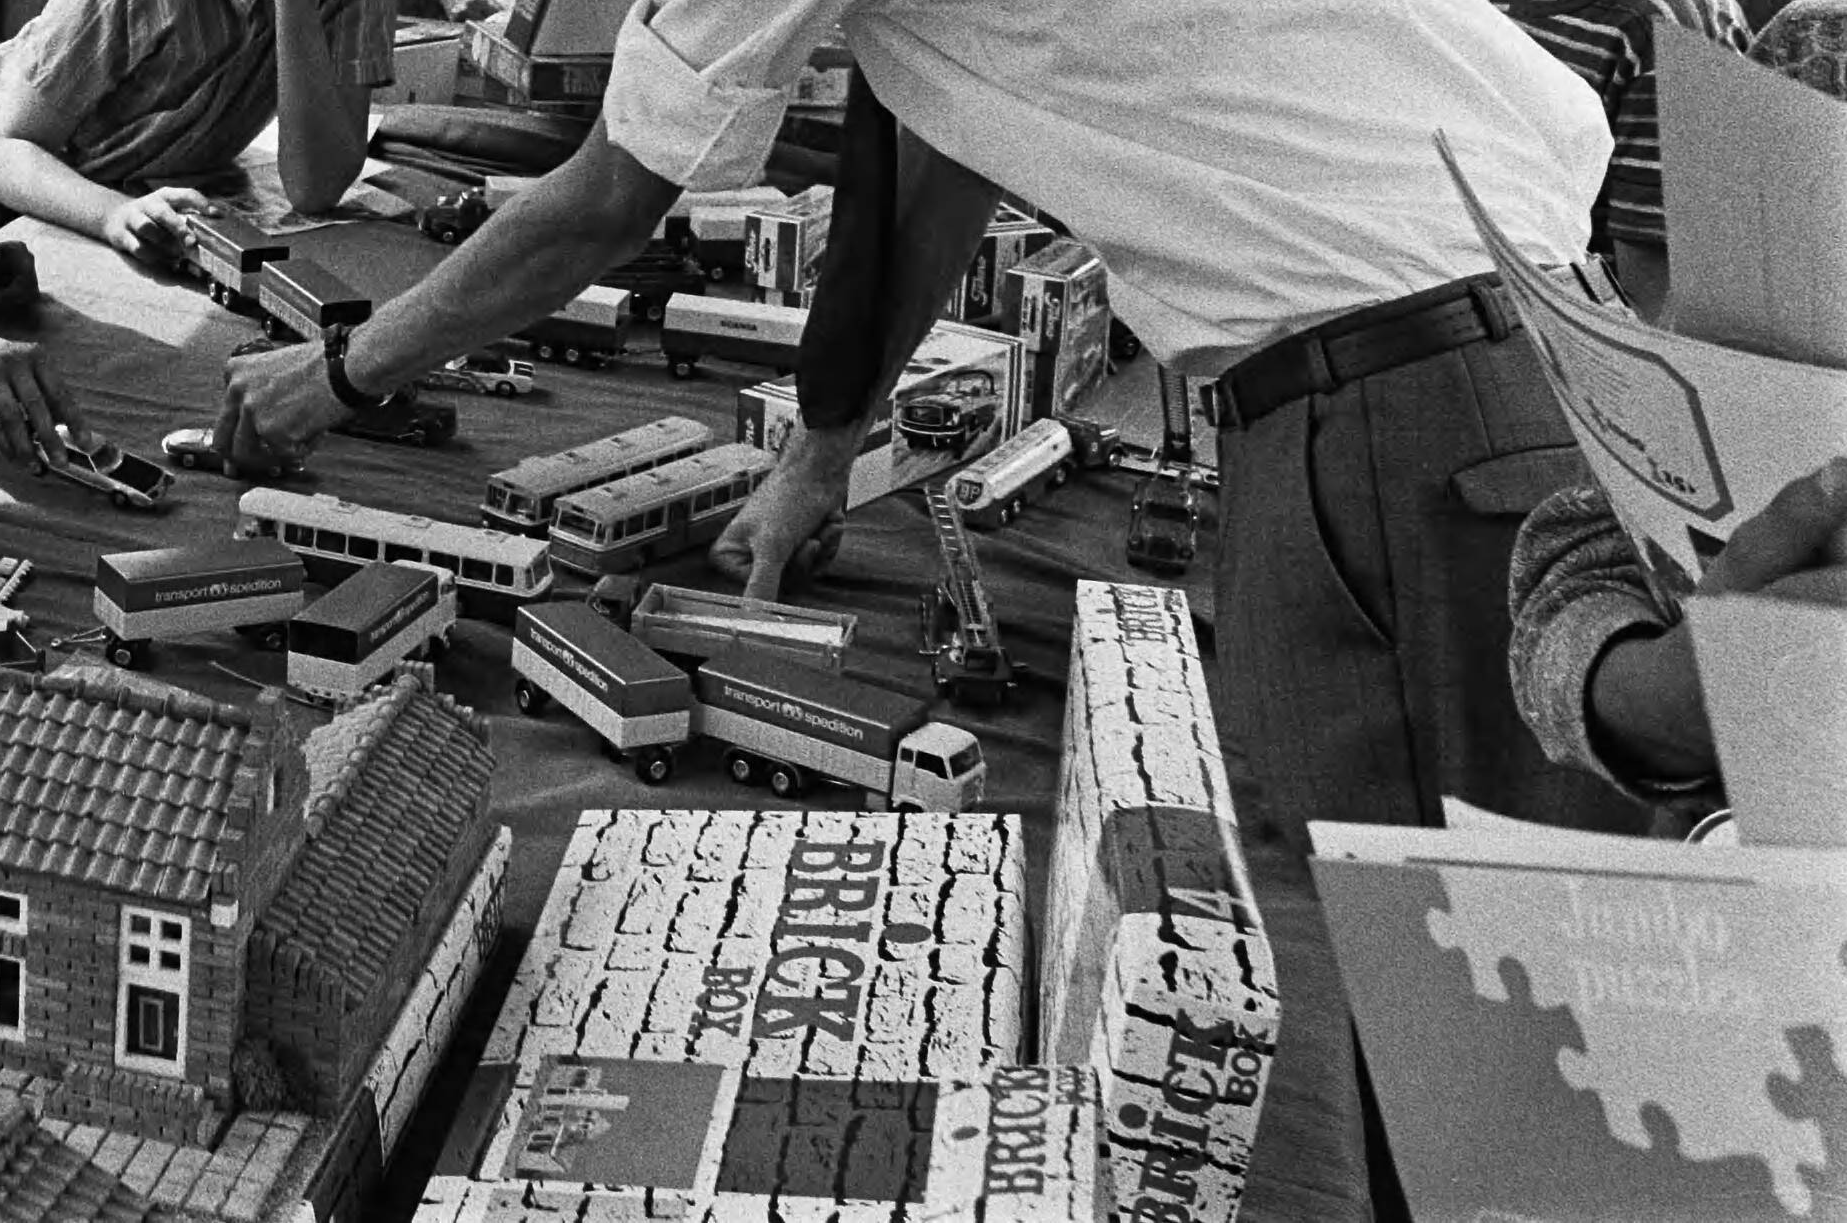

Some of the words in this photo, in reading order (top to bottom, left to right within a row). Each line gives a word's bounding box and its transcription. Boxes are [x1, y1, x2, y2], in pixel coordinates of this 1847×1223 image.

[959, 482, 981, 501] BP
[155, 585, 209, 602] transport
[229, 578, 282, 595] spedition
[530, 627, 563, 659] transport
[723, 684, 781, 714] transport
[803, 710, 864, 740] spedition
[688, 965, 754, 1037] BOX
[1224, 1023, 1269, 1107] BOX
